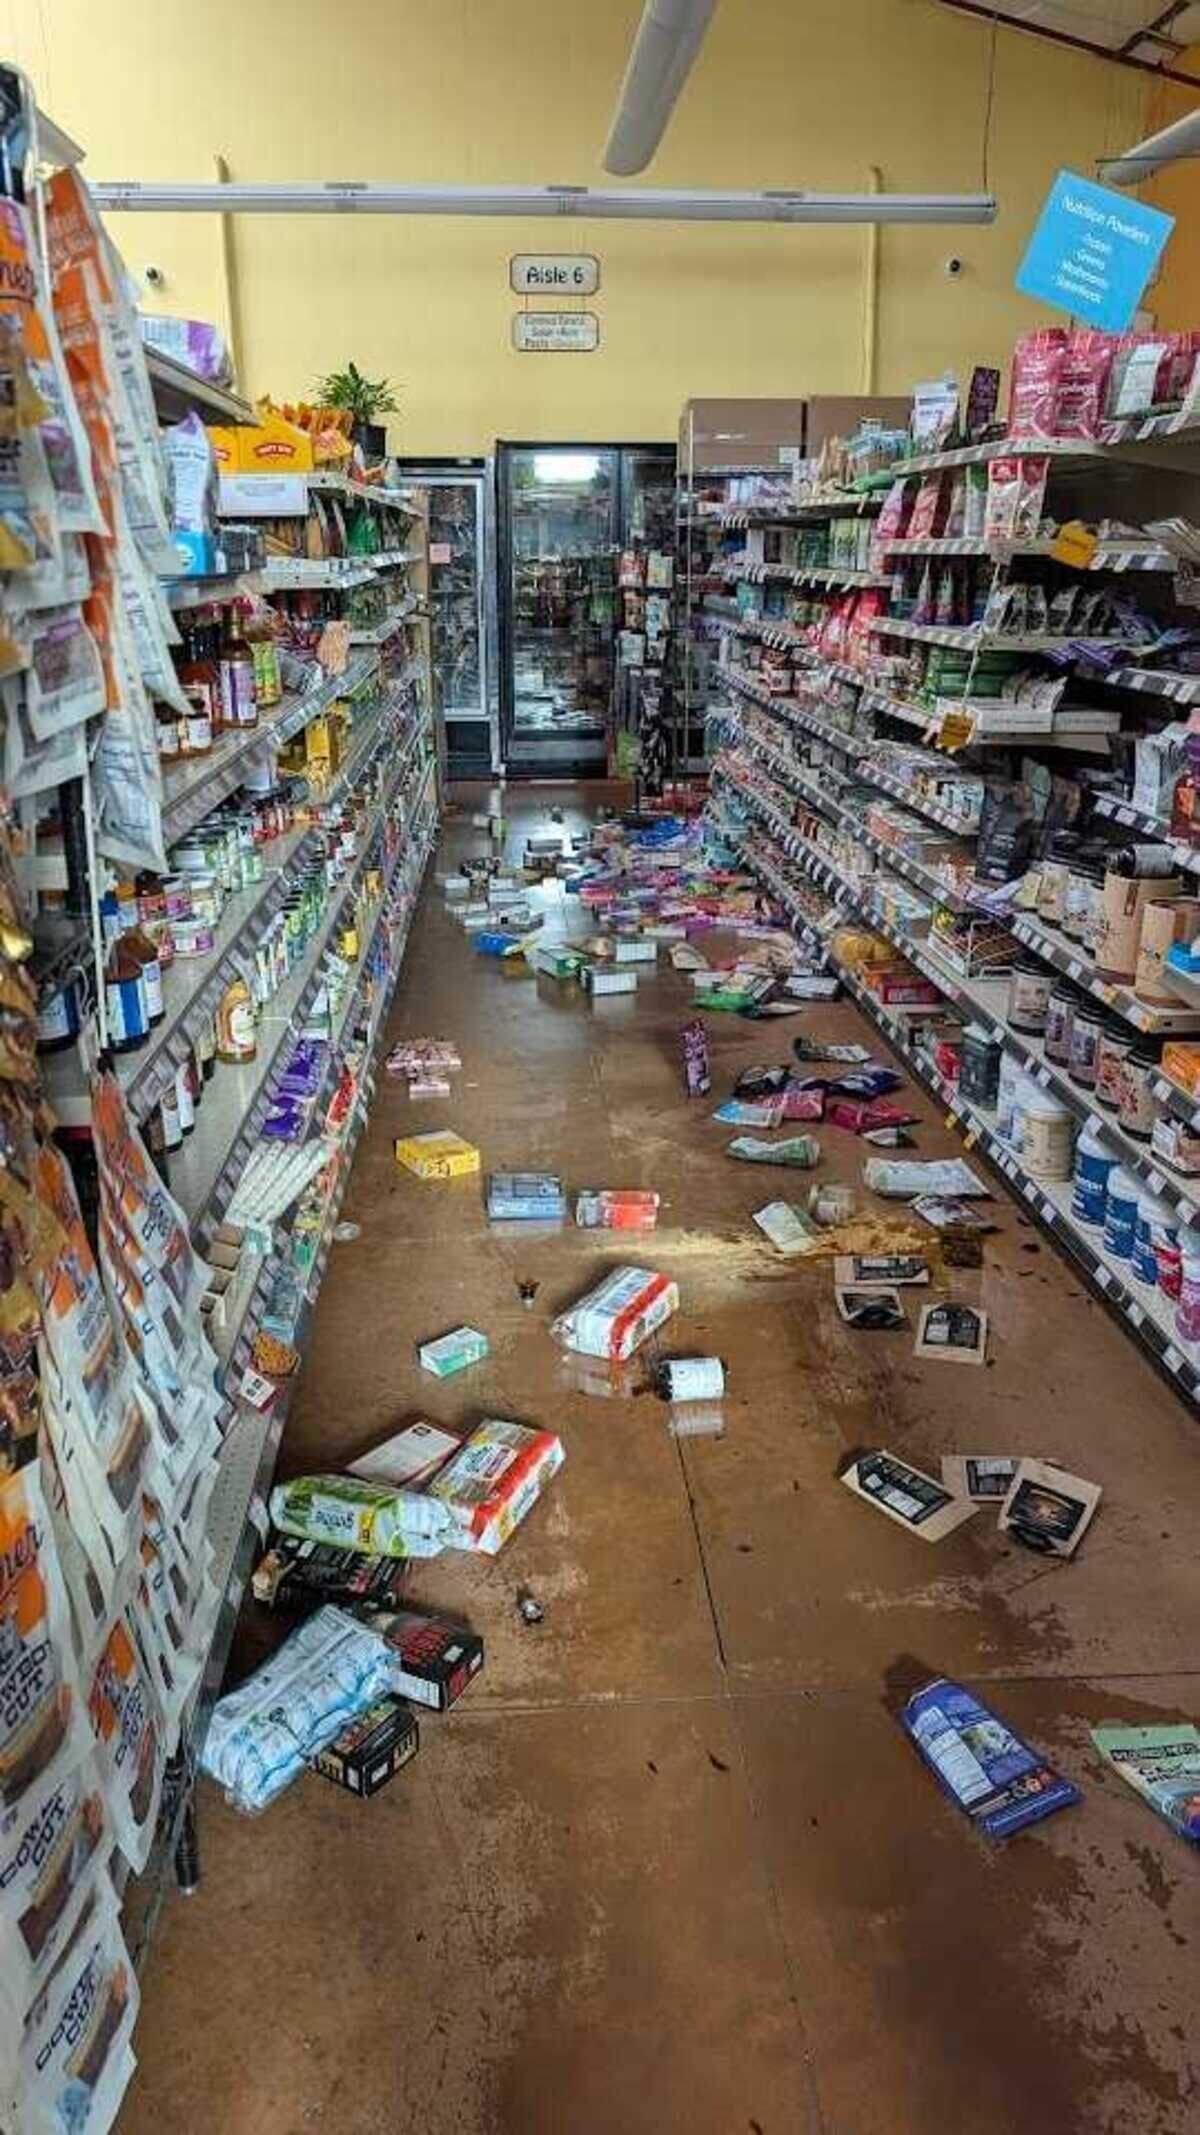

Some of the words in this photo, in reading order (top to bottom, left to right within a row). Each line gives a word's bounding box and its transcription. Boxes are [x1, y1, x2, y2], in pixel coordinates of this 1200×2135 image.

[527, 266, 568, 284] Aisle
[573, 266, 585, 284] 6
[4, 1667, 44, 1728] CUT
